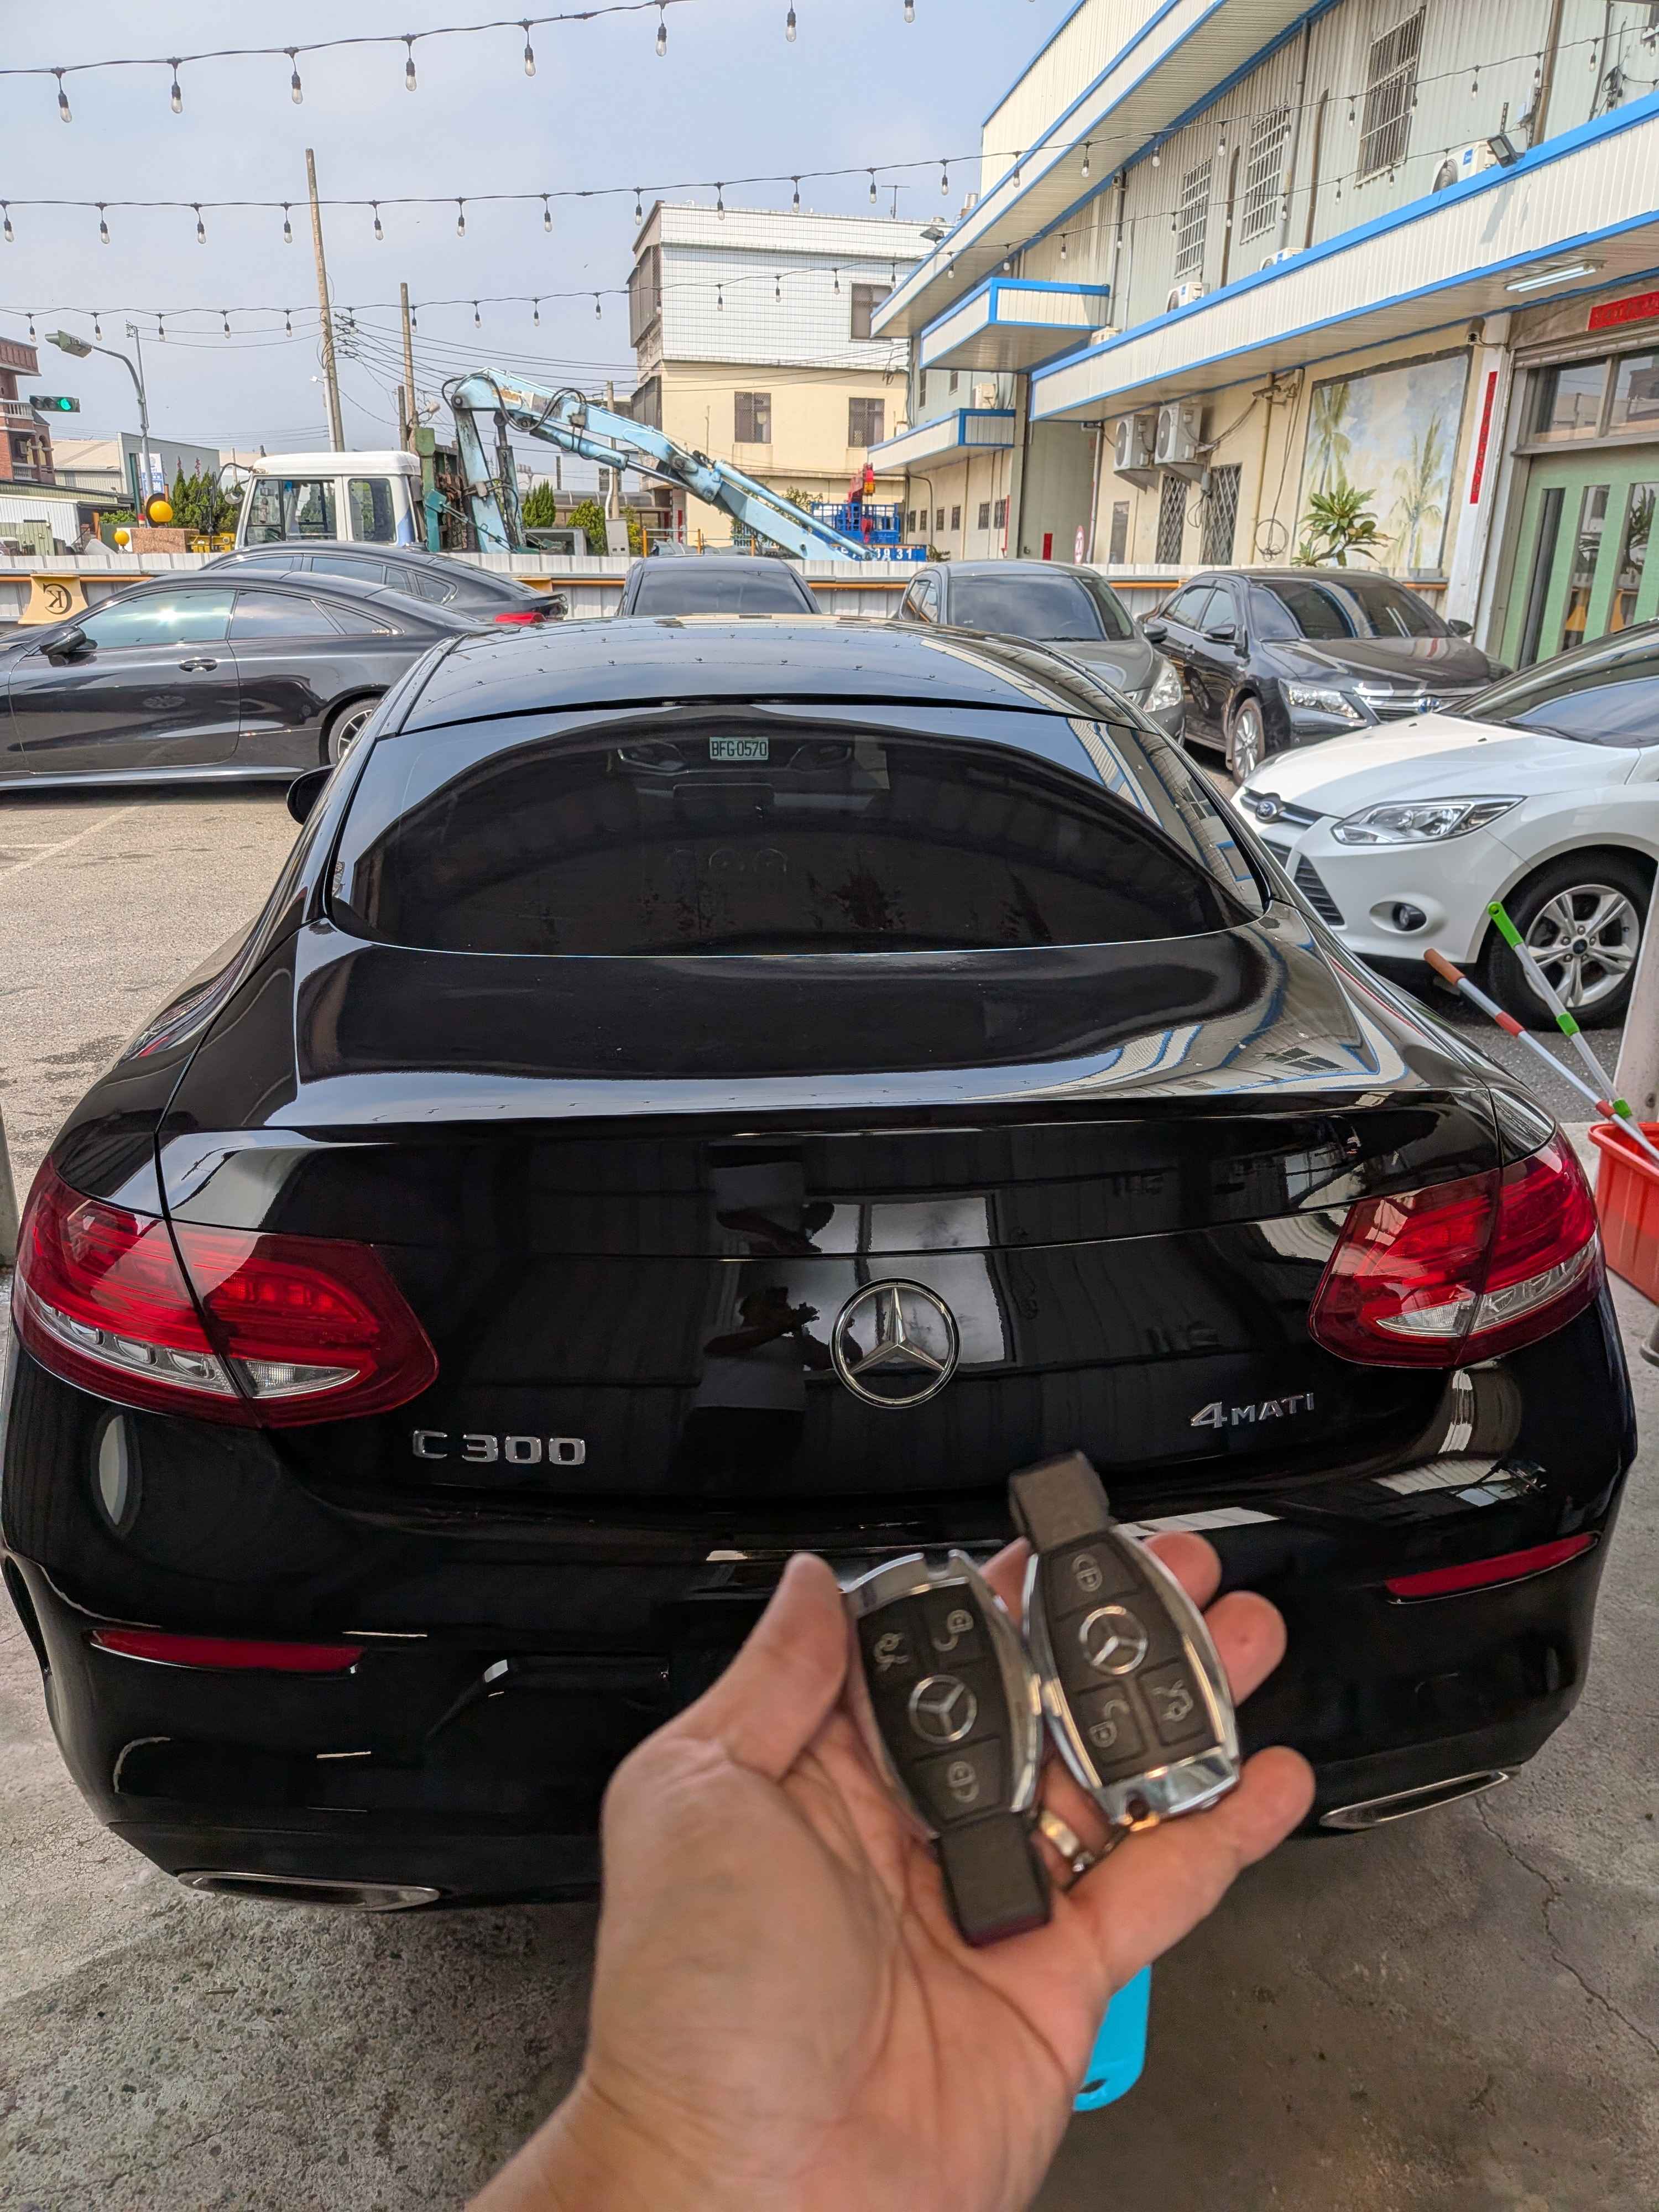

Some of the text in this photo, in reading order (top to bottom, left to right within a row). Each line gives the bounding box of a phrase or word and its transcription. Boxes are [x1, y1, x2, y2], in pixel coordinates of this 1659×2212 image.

[1191, 1392, 1314, 1428] 4MATI
[413, 1430, 586, 1465] C 300
